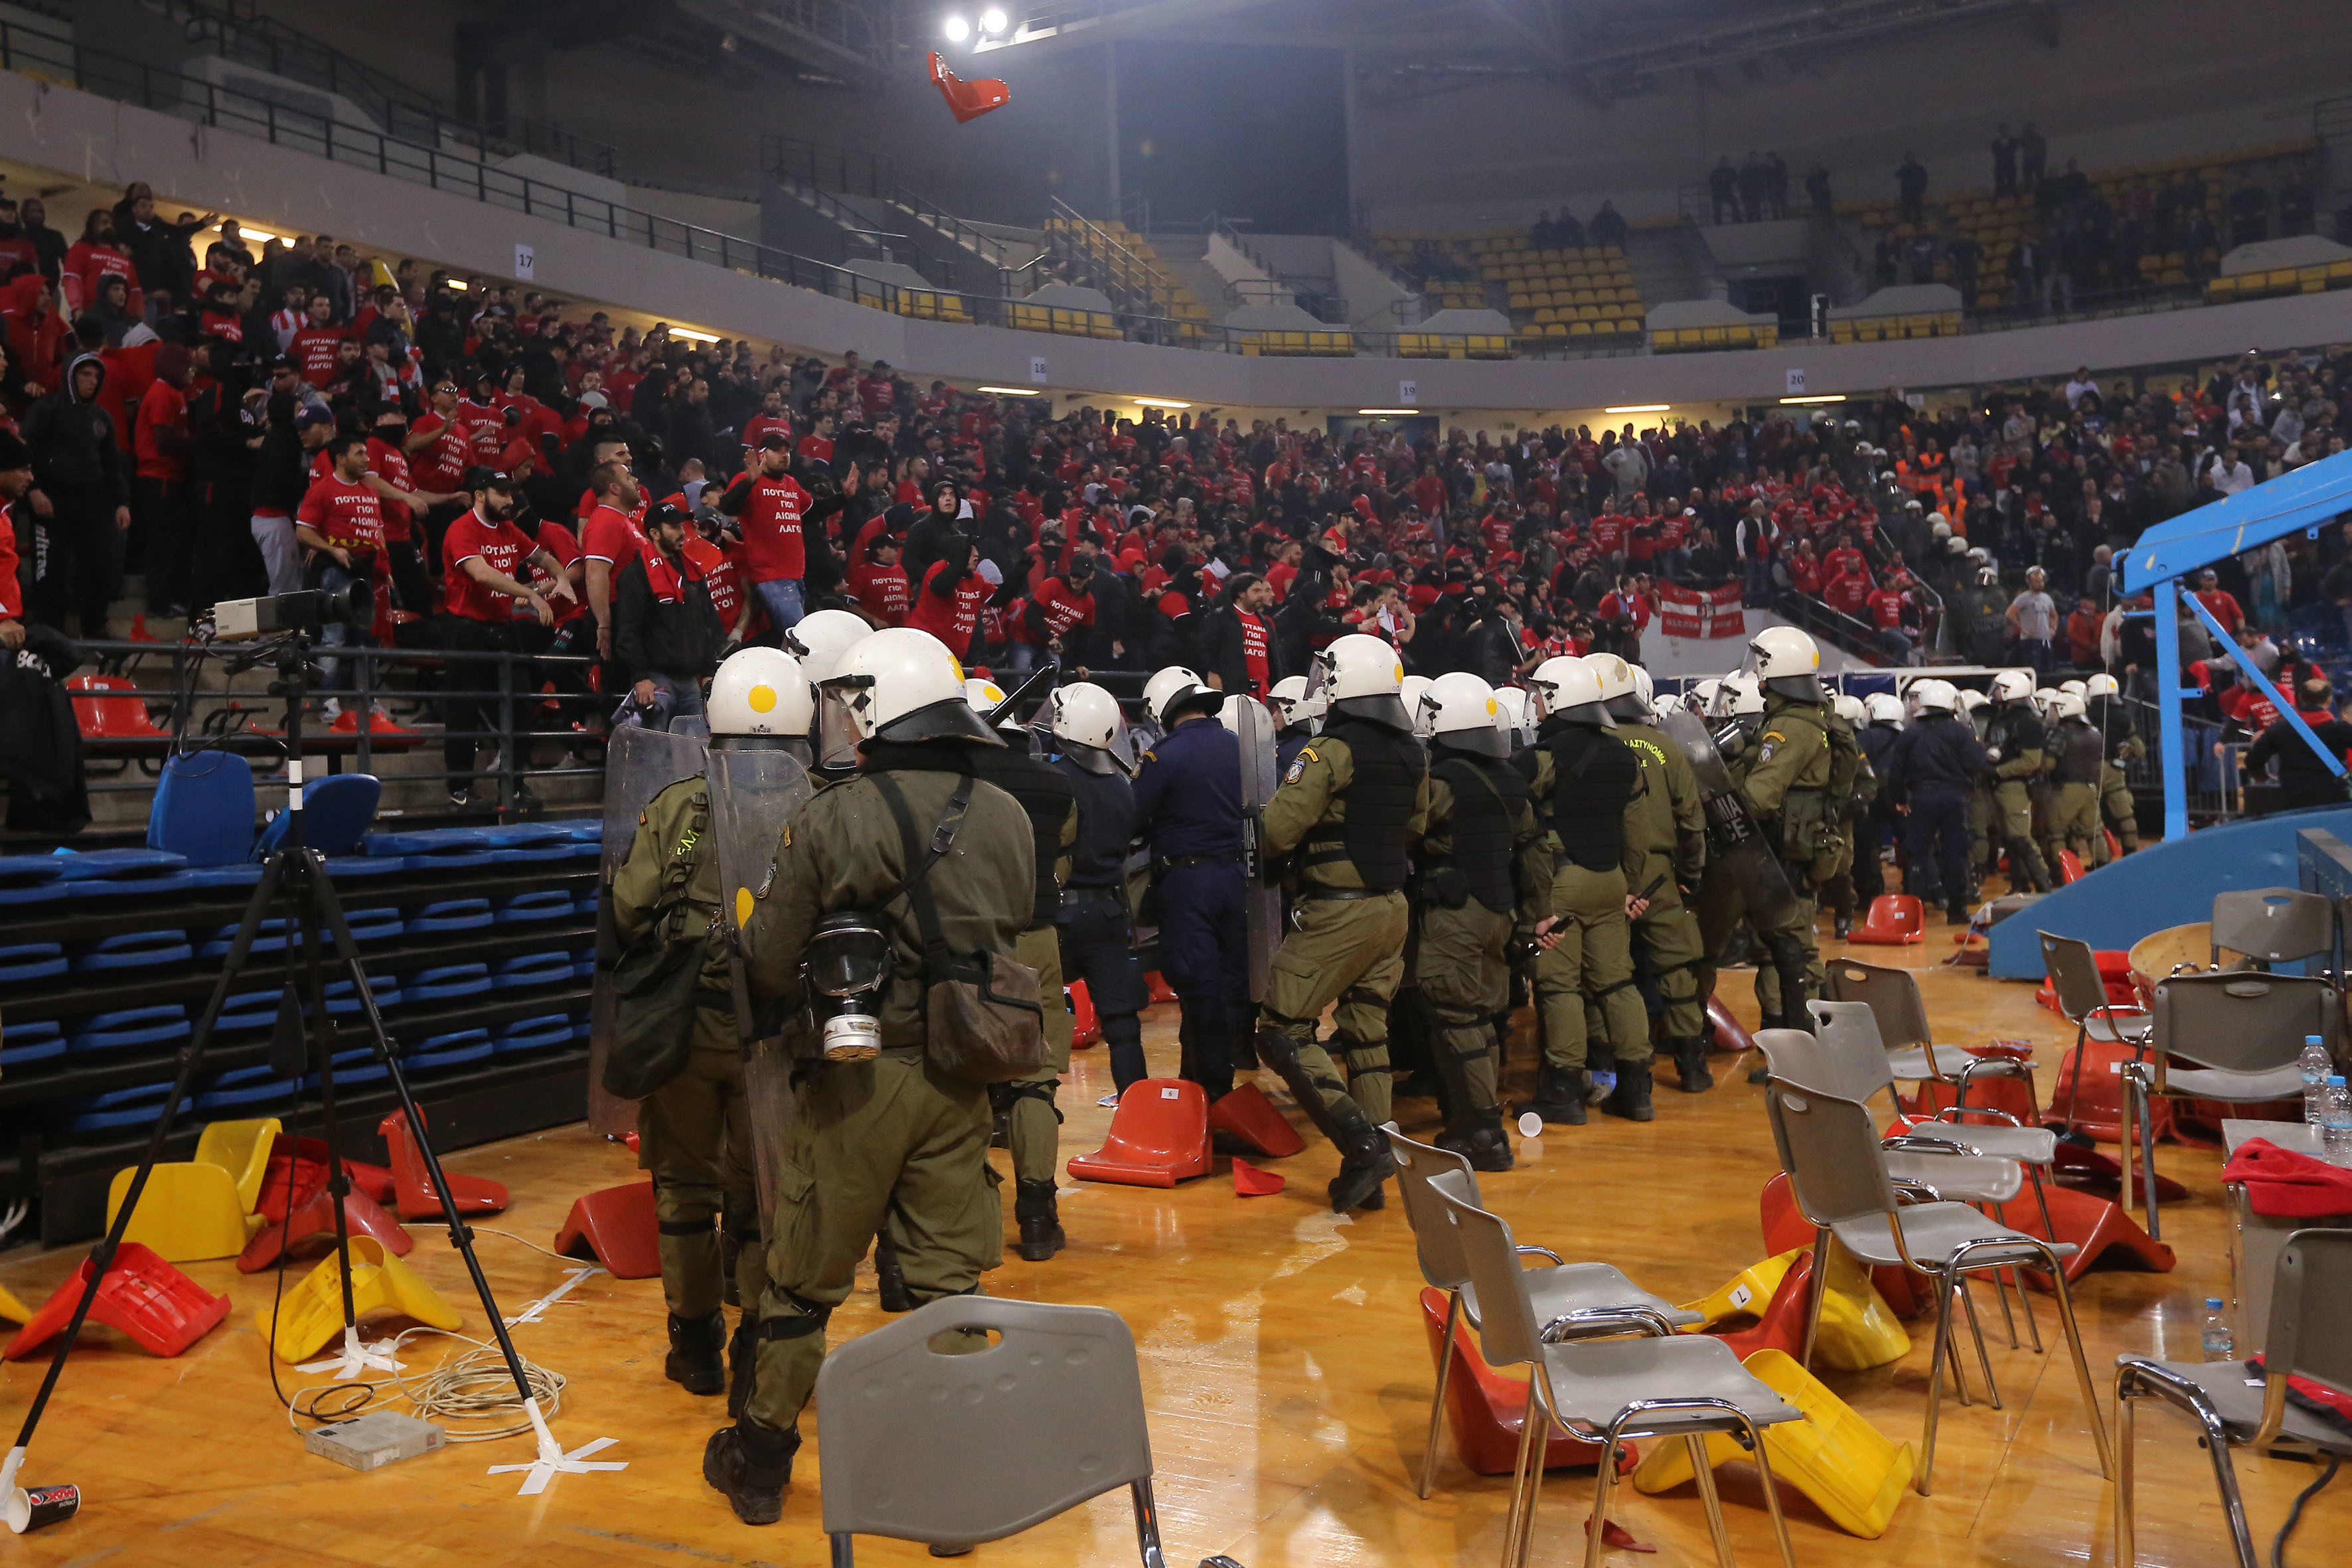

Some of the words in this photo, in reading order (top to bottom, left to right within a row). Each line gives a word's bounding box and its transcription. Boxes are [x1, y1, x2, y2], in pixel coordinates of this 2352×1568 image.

[520, 254, 532, 268] 17
[1034, 363, 1046, 373] 18
[1791, 375, 1804, 385] 20
[1403, 386, 1415, 396] 19
[356, 505, 374, 514] ΓΙΟΙ
[779, 524, 802, 533] ΛΑΓΟ
[1247, 631, 1261, 639] ΓΙΟΙ
[1630, 739, 1667, 765] ΑΣΤΥΝΟΜΙΑ
